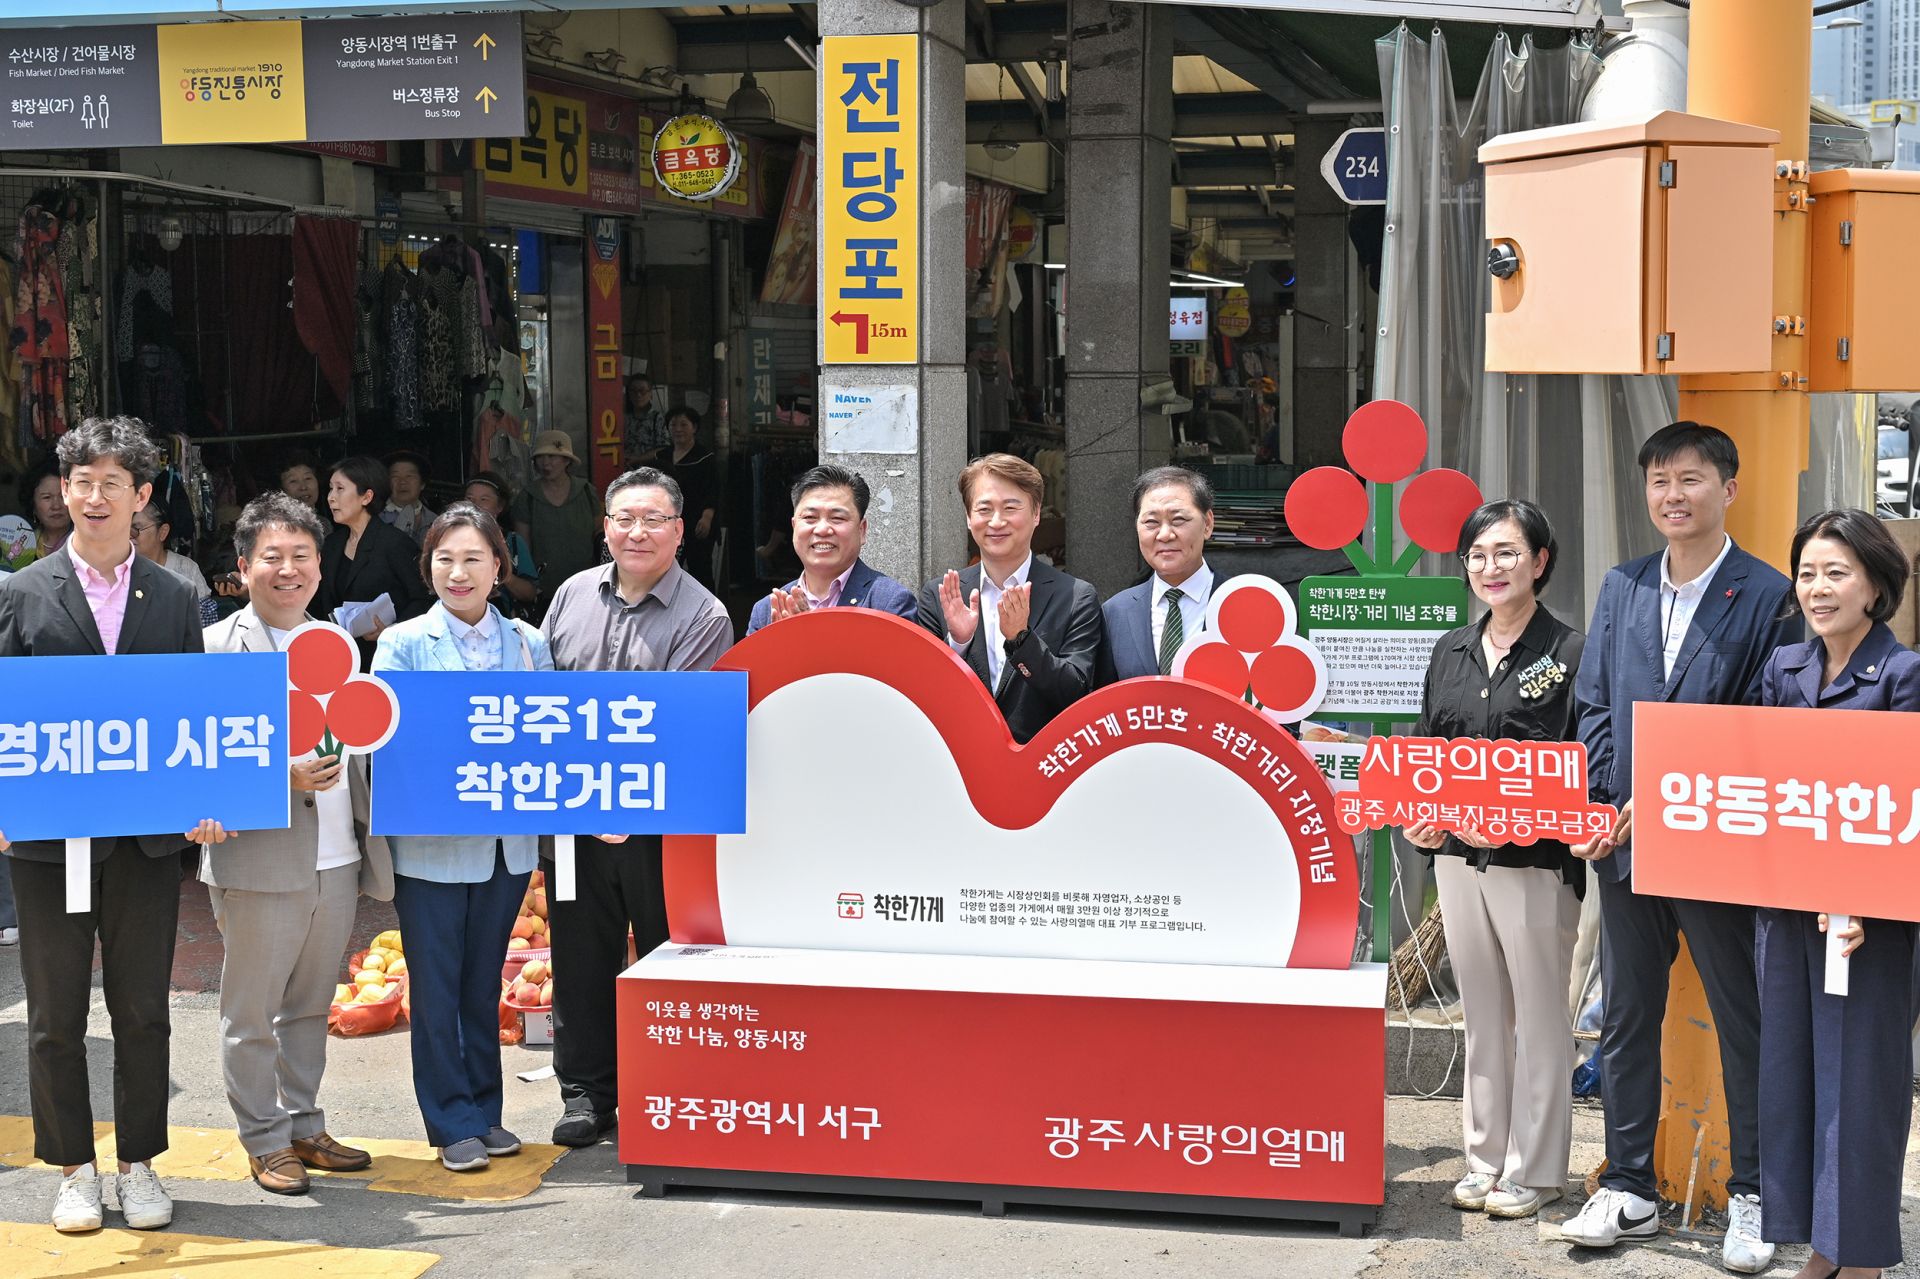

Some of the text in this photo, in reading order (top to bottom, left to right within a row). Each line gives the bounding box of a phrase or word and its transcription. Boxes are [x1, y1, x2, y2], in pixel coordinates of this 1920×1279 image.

[8, 47, 60, 63] 수산시장
[72, 44, 137, 61] 건어물시장
[341, 33, 458, 54] 양동시장역 1번출구
[9, 69, 24, 78] Fish
[26, 68, 52, 77] Market
[59, 67, 80, 76] Dried
[81, 67, 97, 75] Fish
[98, 66, 125, 75] Market
[182, 67, 209, 75] Yangdong
[257, 63, 283, 72] 1910
[336, 55, 459, 69] Yangdong Market Station Exit 1
[392, 86, 460, 104] 버스정류장
[11, 98, 75, 115] 화장실(2F)
[425, 109, 461, 119] Bus Stop
[12, 120, 34, 129] Toilet
[664, 147, 721, 170] 금옥당
[1345, 156, 1380, 178] 234
[840, 58, 905, 300] 전당포
[596, 217, 615, 240] ADT
[1169, 311, 1203, 326] 정육점
[870, 324, 909, 339] 15m
[1309, 587, 1386, 600] 착한가게 5만호 탄생
[1309, 604, 1458, 622] 착한시장·거리 기념 조형물
[1518, 654, 1554, 684] 서구의원
[1522, 665, 1564, 699] 김수영
[467, 694, 657, 745] 광주1호
[0, 714, 275, 777] 경제의 시작
[1314, 754, 1361, 780] 랫폼
[1365, 743, 1580, 797] 사랑의열매
[456, 761, 666, 811] 착한거리
[1037, 712, 1123, 779] 착한가게
[1126, 705, 1188, 732] 5만호
[1212, 721, 1298, 793] 착한거리
[1289, 789, 1337, 884] 지정기념
[1340, 798, 1611, 838] 광주 사회복지공동모금회
[960, 888, 1182, 905] 착한가게는 시장상인회를 비롯해 자영업자, 소상공인 등
[873, 894, 944, 922] 착한가게
[960, 901, 1169, 917] 다양한 업종의 가게에서 매월 3만원 이상 정기적으로
[960, 914, 1207, 932] 나눔에 참여할 수 있는 사랑의열매 대표 기부 프로그램입니다.
[646, 1001, 760, 1022] 이웃을 생각하는
[646, 1024, 807, 1051] 착한 나눔, 양동시장
[644, 1095, 882, 1141] 광주광역시 서구
[1045, 1116, 1345, 1168] 광주 사랑의열매
